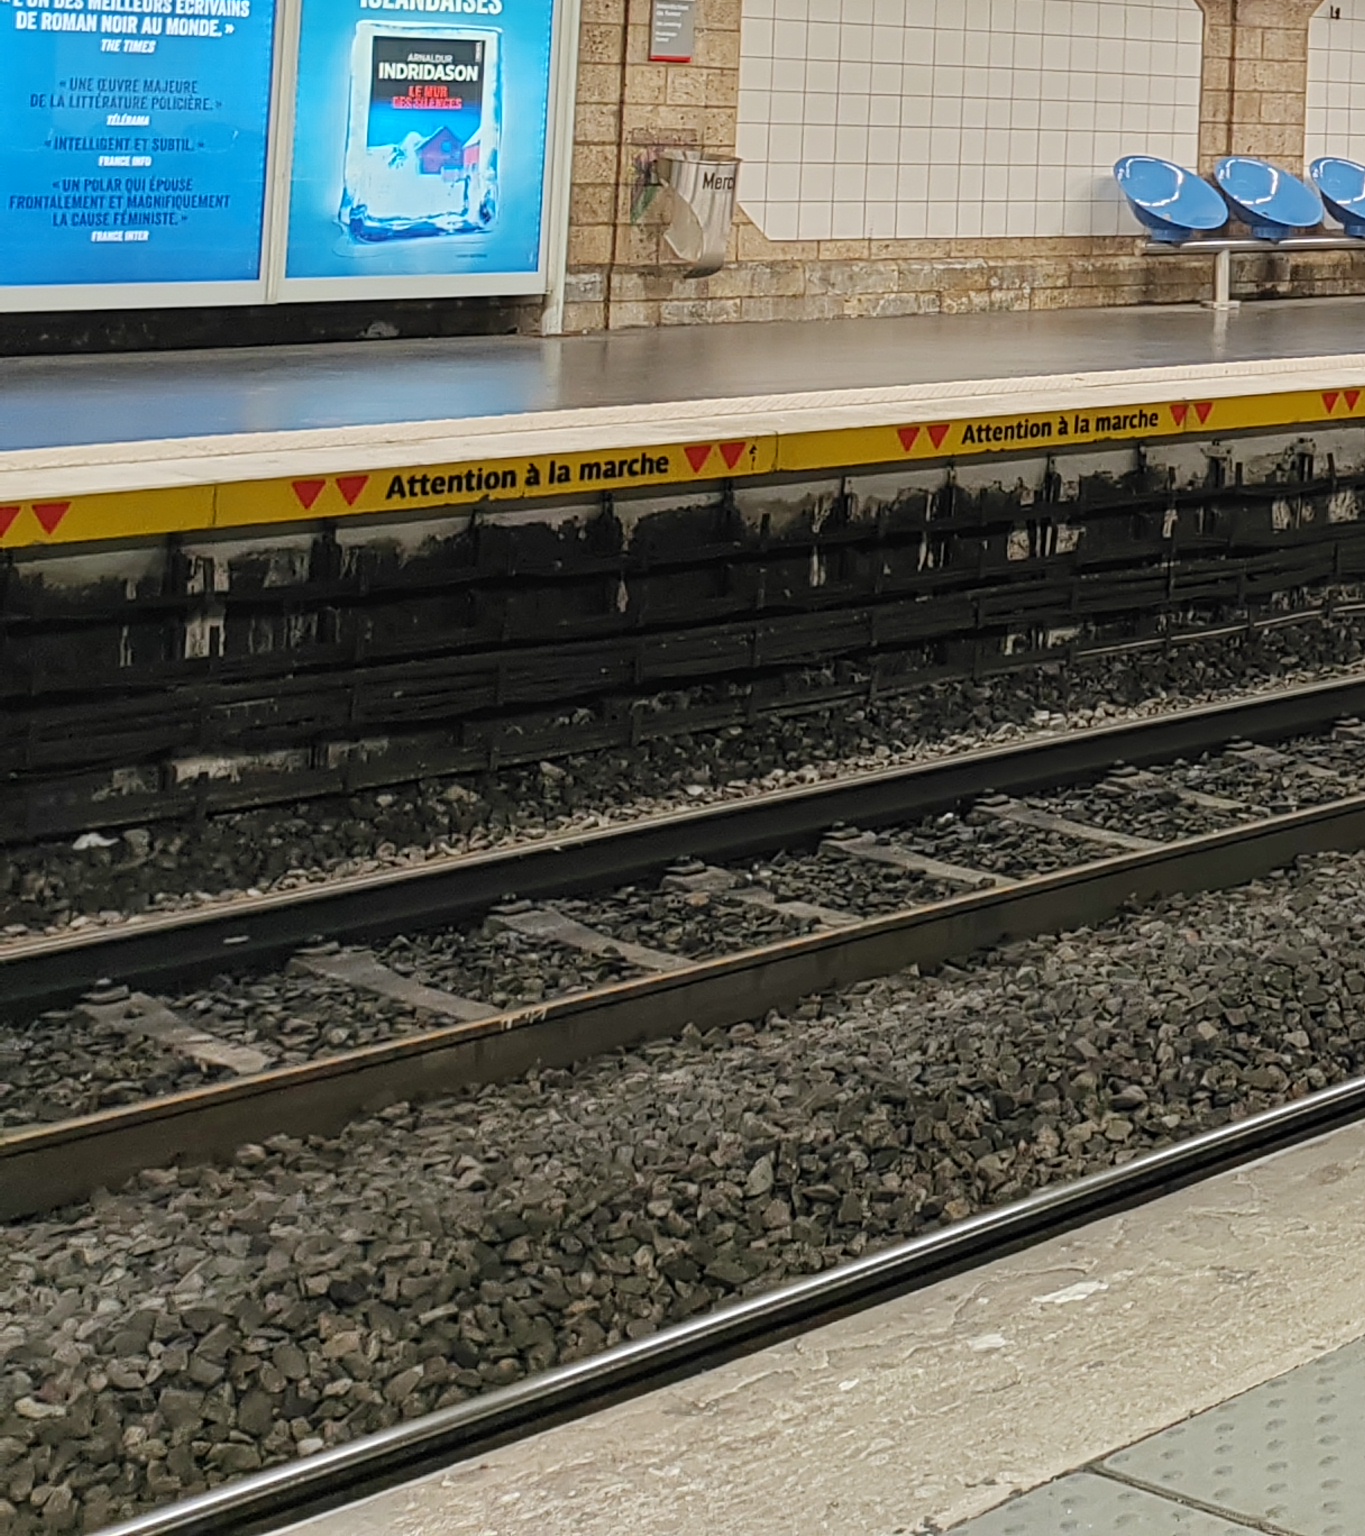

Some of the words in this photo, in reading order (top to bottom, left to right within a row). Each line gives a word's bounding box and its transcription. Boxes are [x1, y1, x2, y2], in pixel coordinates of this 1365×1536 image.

[16, 11, 36, 31] DE
[41, 12, 97, 33] ROMAN
[101, 14, 137, 35] NOIR
[141, 16, 162, 36] AU
[166, 17, 222, 38] MONDE.
[101, 39, 121, 52] THE
[123, 39, 156, 53] TIMES
[407, 53, 454, 64] ARNALDUR
[378, 62, 479, 82] INDRIDASON
[69, 77, 93, 92] UNE
[143, 78, 198, 94] MAJEURE
[30, 93, 46, 108] DE
[51, 94, 65, 108] LA
[69, 92, 148, 110] LITTÉRATURE
[54, 136, 130, 151] INTELLIGENT
[134, 137, 149, 151] ET
[62, 178, 80, 192] UN
[84, 178, 122, 192] POLAR
[125, 178, 146, 194] QUI
[149, 175, 193, 192] ÉPOUSE
[9, 195, 105, 210] FRONTALEMENT
[109, 195, 123, 209] ET
[127, 194, 231, 210] MAGNIFIQUEMENT
[52, 213, 68, 227] LA
[71, 212, 110, 227] CAUSE
[961, 419, 1052, 445] Attention
[1058, 416, 1069, 436] à
[1074, 415, 1090, 434] la
[1095, 409, 1159, 433] marche
[385, 467, 517, 500] Attention
[525, 463, 540, 487] à
[548, 460, 571, 485] la
[579, 452, 670, 481] marche
